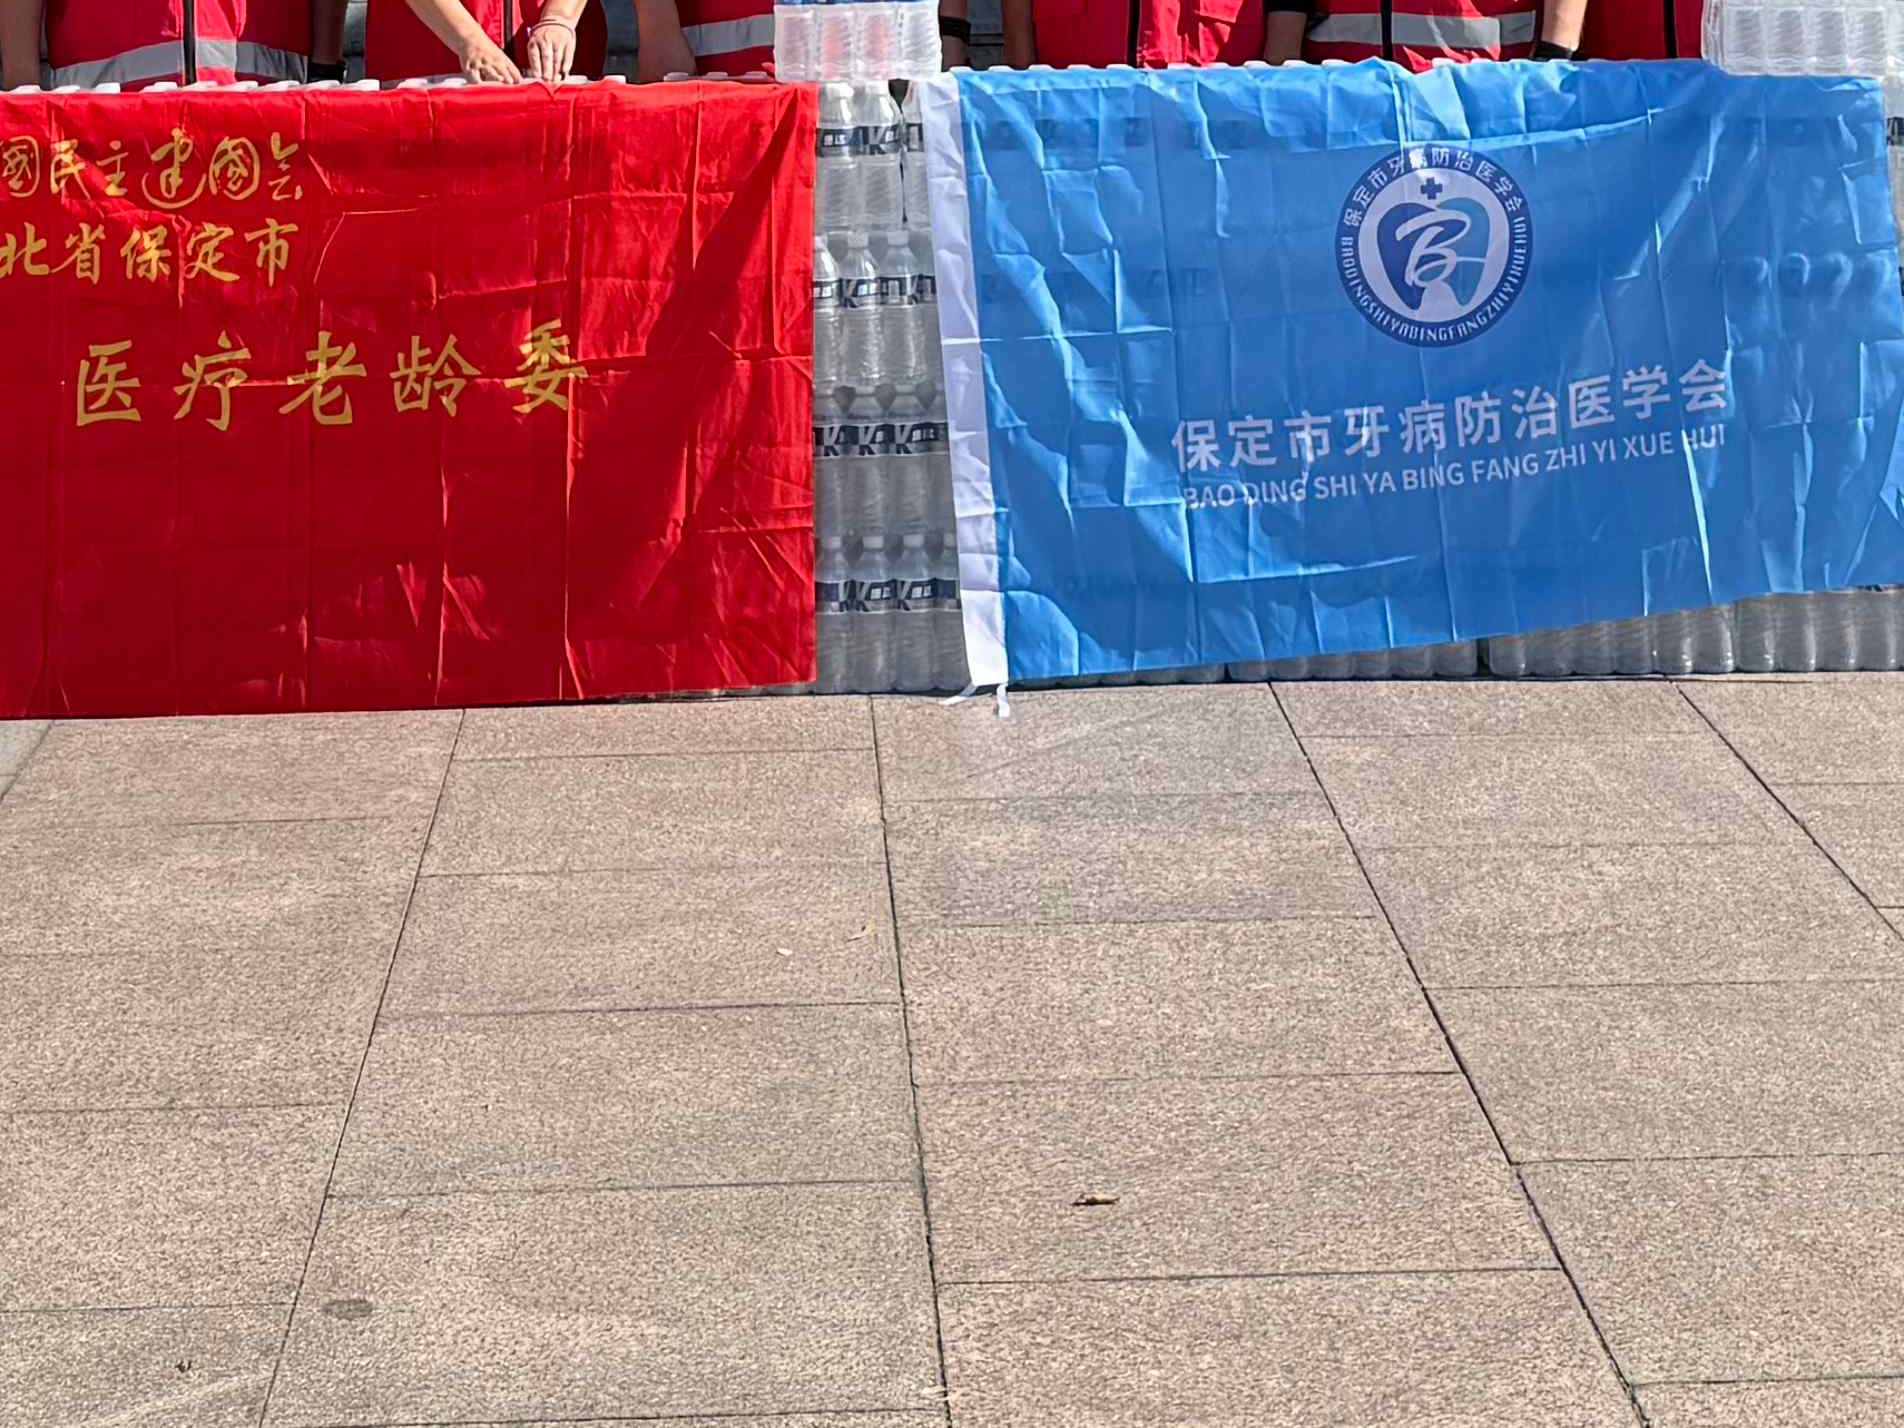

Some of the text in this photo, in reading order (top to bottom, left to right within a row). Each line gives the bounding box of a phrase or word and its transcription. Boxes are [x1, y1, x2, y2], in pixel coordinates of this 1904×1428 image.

[76, 318, 588, 431] 医疗老龄委
[1171, 358, 1729, 472] 保定市牙病防治医学会
[1183, 482, 1235, 510] BAO
[1243, 477, 1308, 506] DING
[1313, 474, 1357, 499] SHI
[1363, 470, 1396, 494] YA
[1402, 462, 1465, 491] BING
[1471, 453, 1539, 483] FANG
[1546, 446, 1586, 472] ZHI
[1592, 440, 1617, 464] YI
[1623, 432, 1673, 459] XUE
